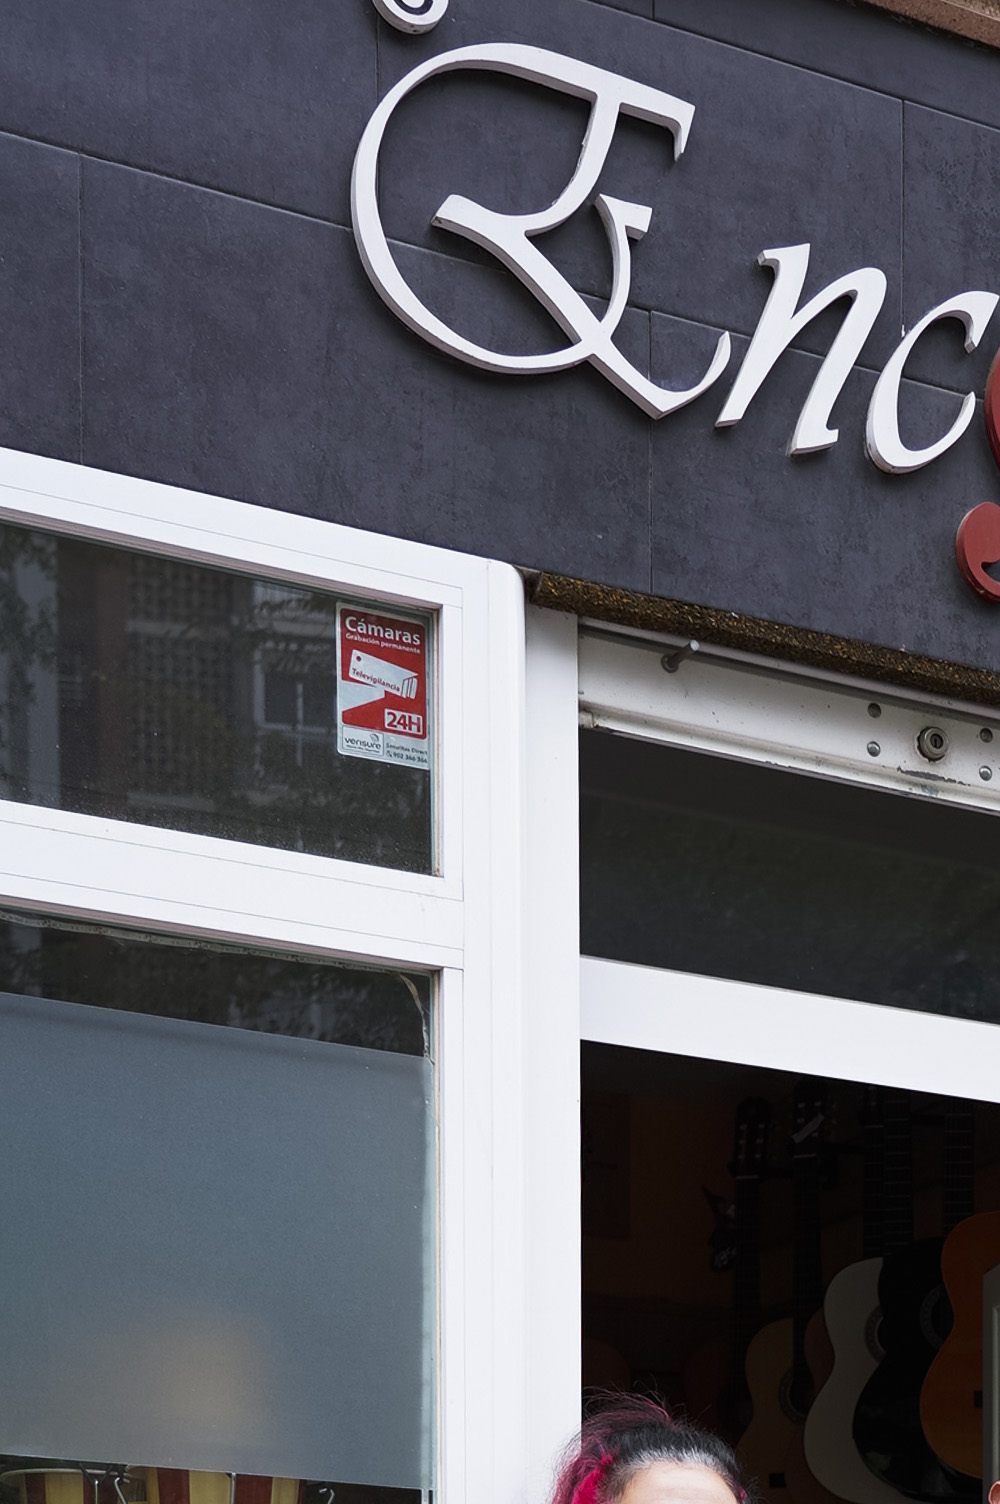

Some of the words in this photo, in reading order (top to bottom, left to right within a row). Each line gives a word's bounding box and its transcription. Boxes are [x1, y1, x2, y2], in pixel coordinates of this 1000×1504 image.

[344, 616, 421, 646] Cámaras
[345, 633, 380, 646] Grabación
[381, 641, 421, 655] permanente
[352, 668, 401, 693] Televigilancia
[387, 711, 422, 734] 24H
[344, 737, 382, 750] verisure
